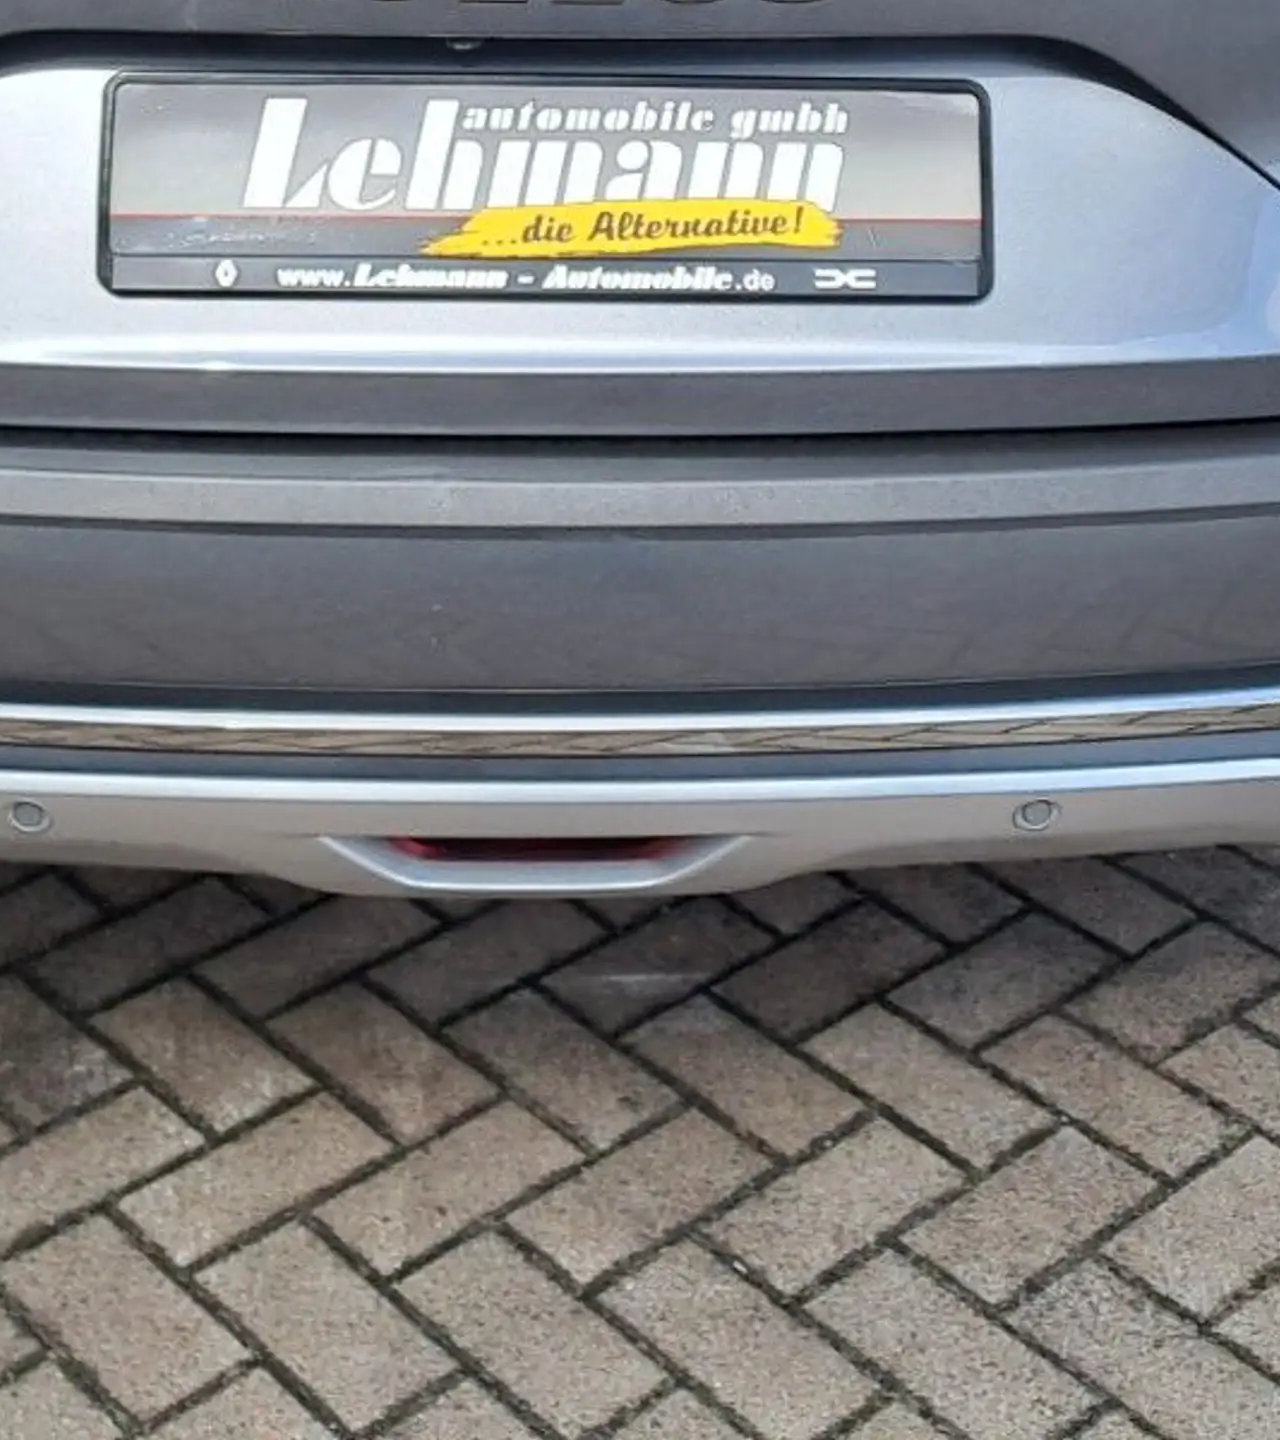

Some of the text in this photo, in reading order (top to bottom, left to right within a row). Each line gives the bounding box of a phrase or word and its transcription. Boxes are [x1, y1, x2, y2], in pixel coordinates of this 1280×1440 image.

[462, 100, 849, 139] automobile gmbh
[243, 96, 845, 213] Lehmann
[587, 205, 805, 242] Alternative!
